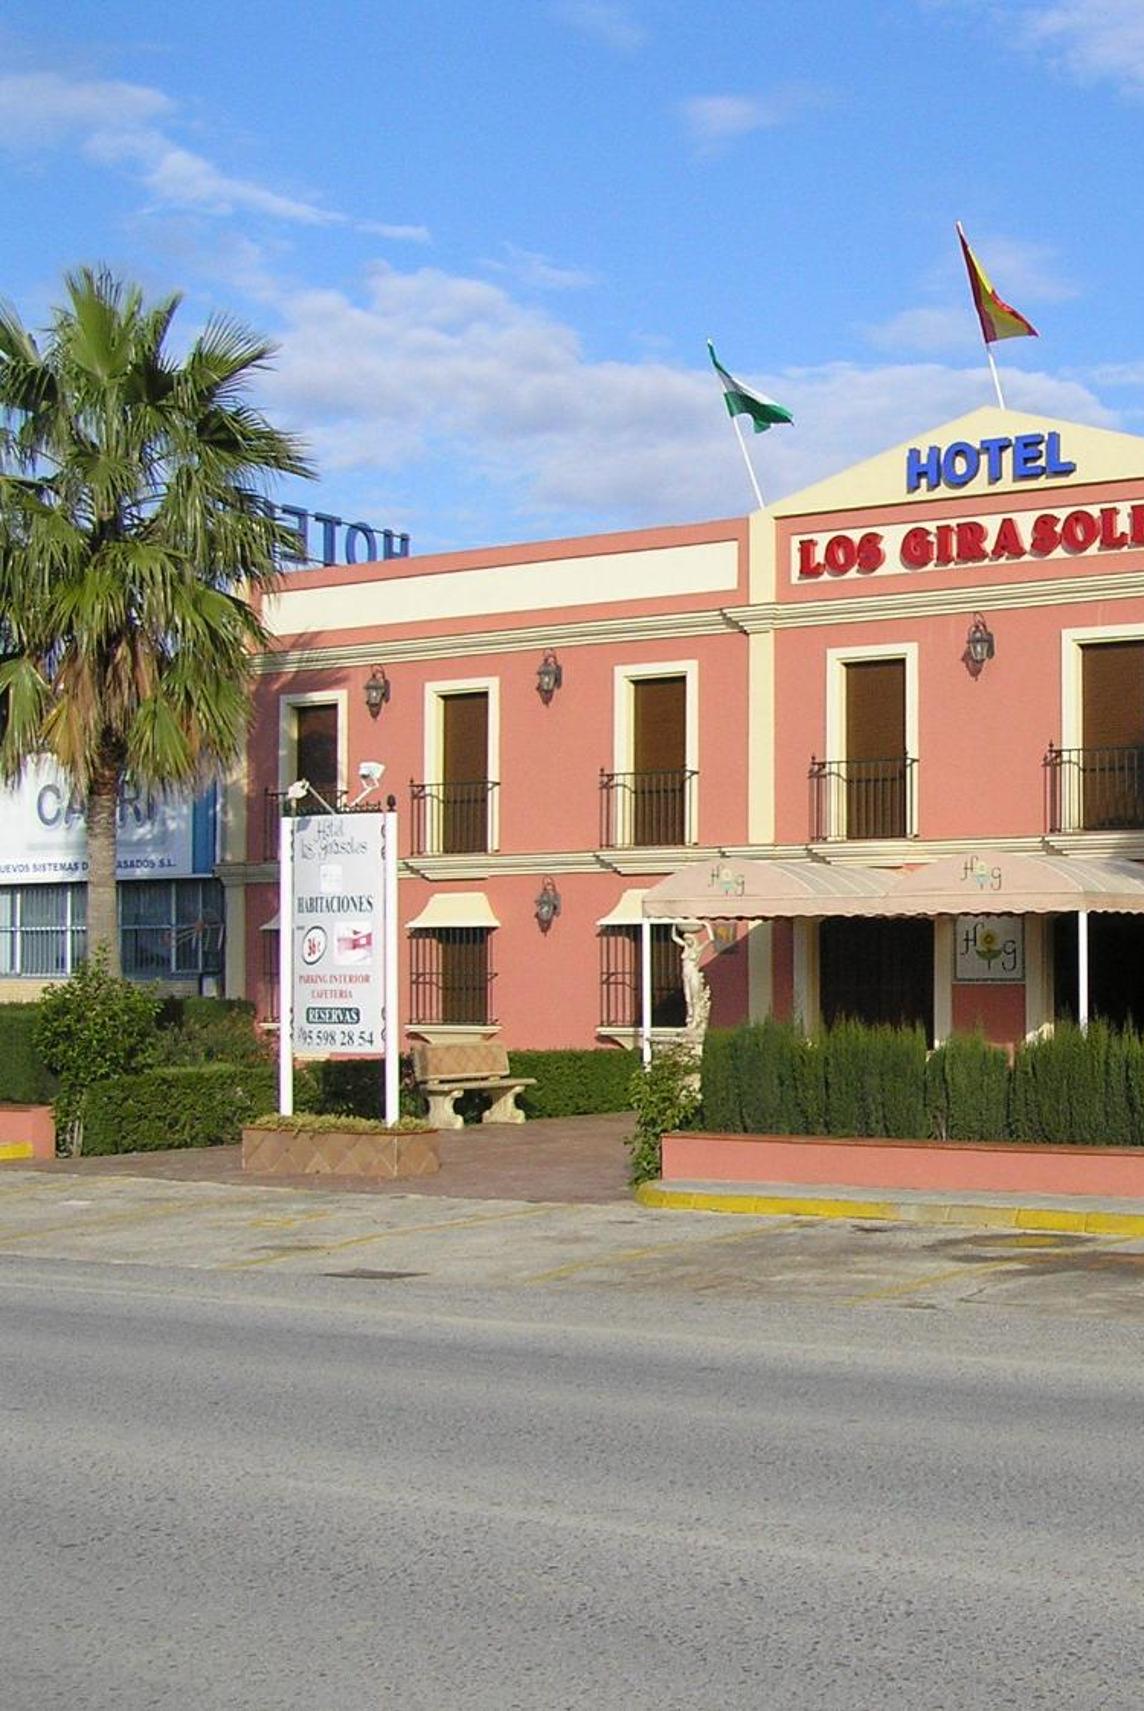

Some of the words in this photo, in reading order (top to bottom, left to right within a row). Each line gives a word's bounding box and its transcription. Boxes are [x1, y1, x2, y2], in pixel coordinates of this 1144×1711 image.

[907, 431, 1076, 493] HOTEL
[798, 533, 886, 580] LOS
[32, 862, 79, 873] SISTEMAS
[297, 895, 374, 913] HABITACIONES
[299, 974, 328, 985] PARKING
[329, 974, 371, 985] INTERIOR
[309, 1008, 359, 1021] RESERVAS
[315, 1030, 337, 1047] 598
[340, 1030, 355, 1047] 28
[358, 1030, 374, 1048] 54
